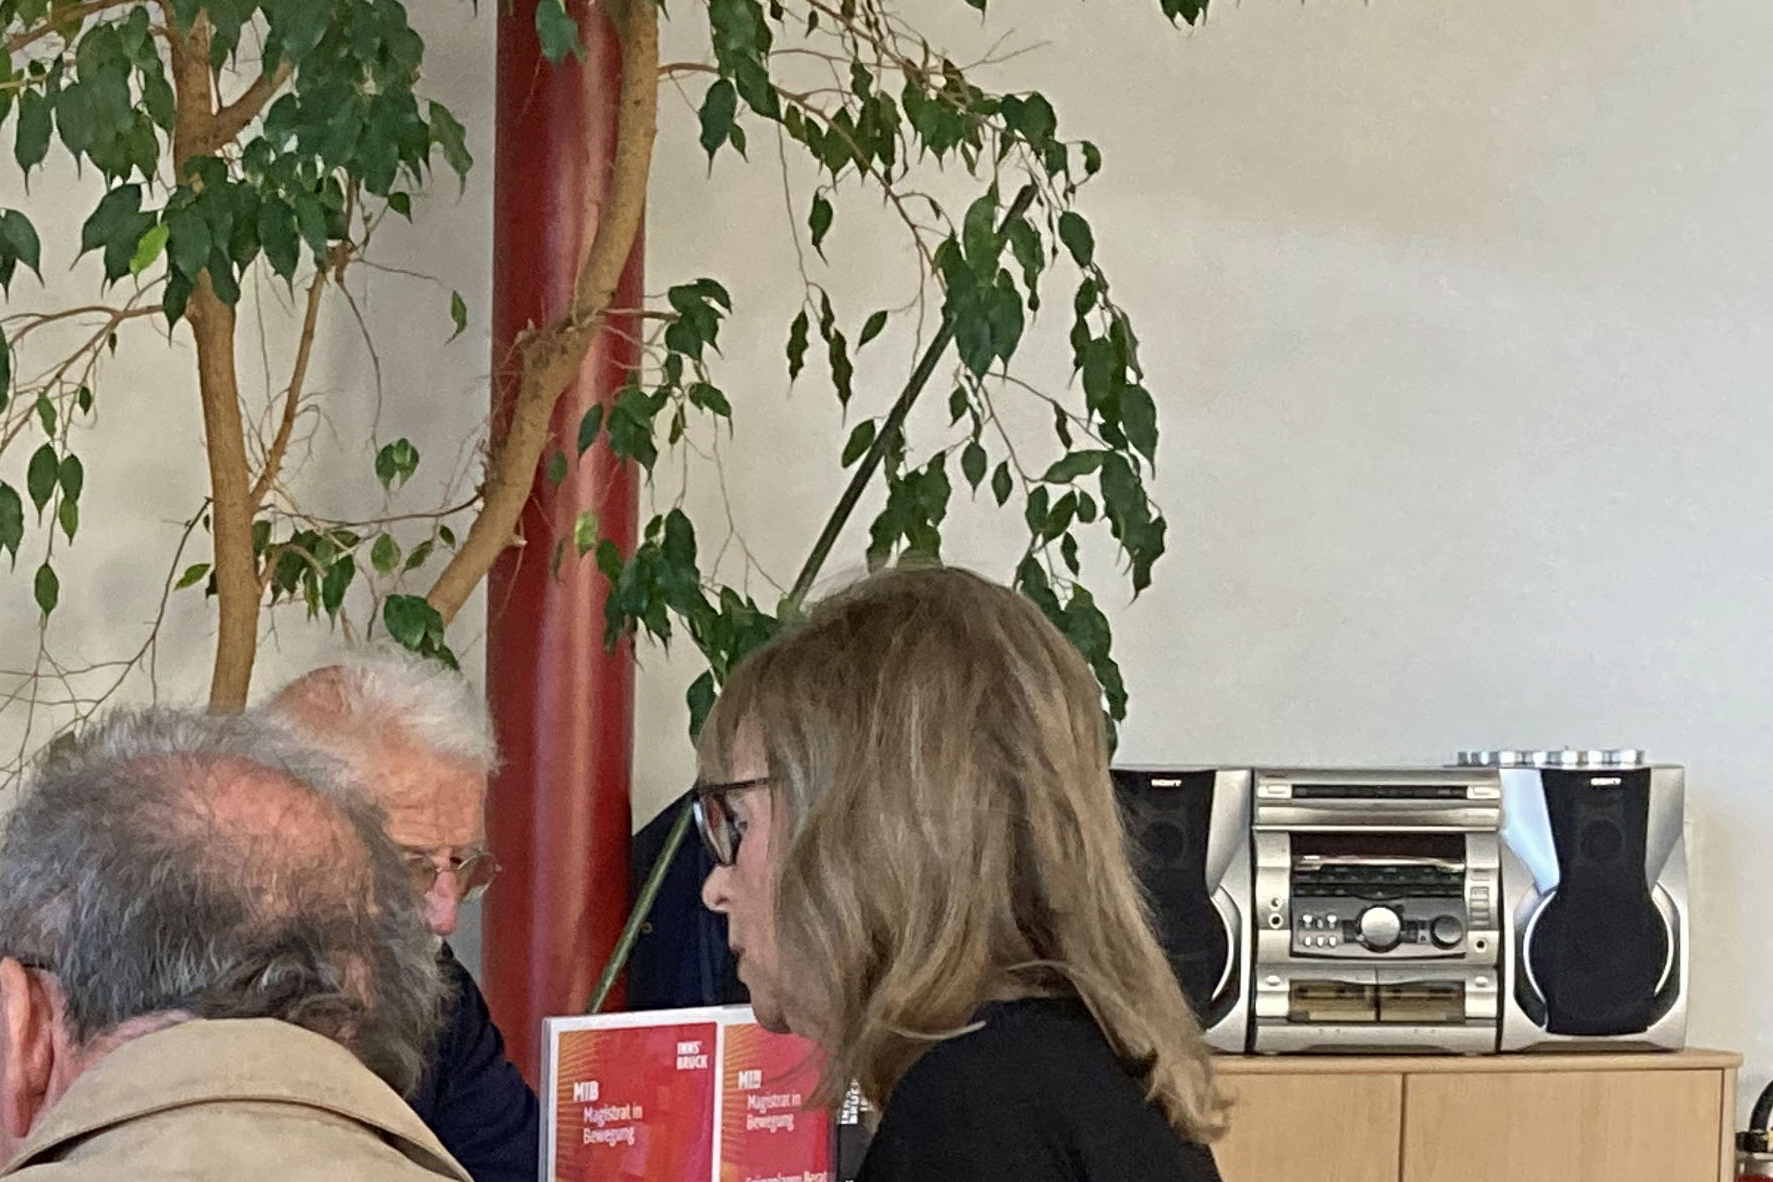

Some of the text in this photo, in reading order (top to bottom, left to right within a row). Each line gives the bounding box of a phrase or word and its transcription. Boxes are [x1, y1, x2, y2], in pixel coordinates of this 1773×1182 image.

[676, 1054, 707, 1070] BRUCK
[738, 1069, 762, 1089] MIB
[573, 1081, 599, 1102] MIB
[747, 1091, 802, 1114] Magistrat in
[584, 1103, 643, 1127] Magistrat in
[746, 1113, 794, 1133] Bewegung
[583, 1127, 635, 1147] Bewegung
